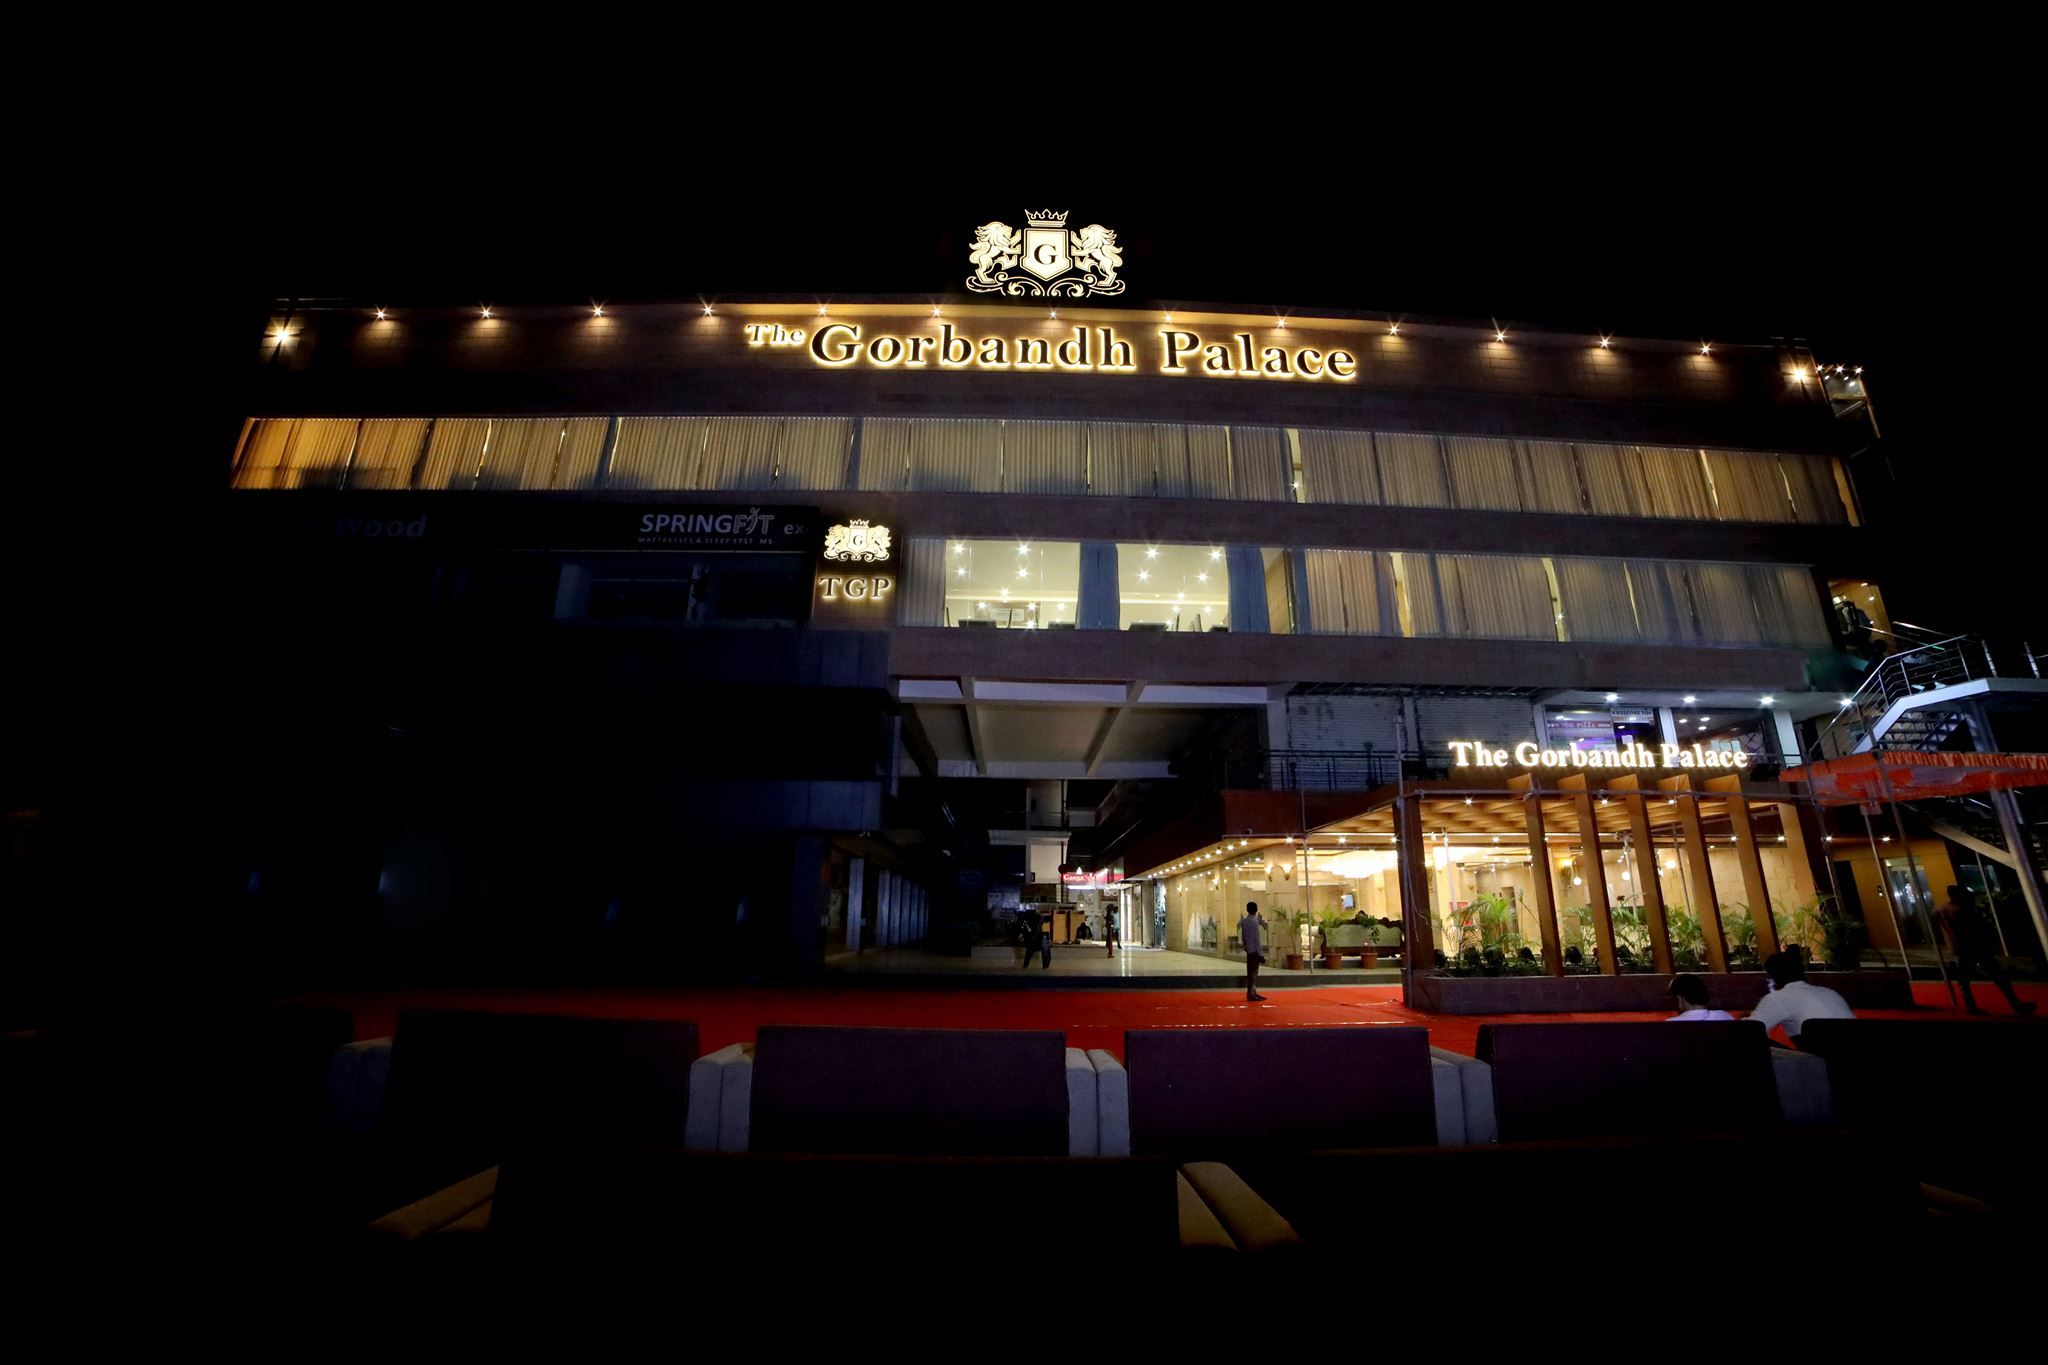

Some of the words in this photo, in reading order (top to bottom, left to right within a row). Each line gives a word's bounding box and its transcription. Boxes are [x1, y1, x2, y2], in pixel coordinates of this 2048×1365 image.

[1033, 243, 1058, 265] G
[745, 322, 805, 345] The
[811, 323, 1136, 368] Gorbandh
[1159, 329, 1358, 378] Palace
[639, 508, 775, 535] SPRINGFIT
[818, 574, 892, 600] TGP
[1448, 741, 1508, 767] The
[1514, 741, 1656, 768] Gorbandh
[1658, 743, 1749, 769] Palace
